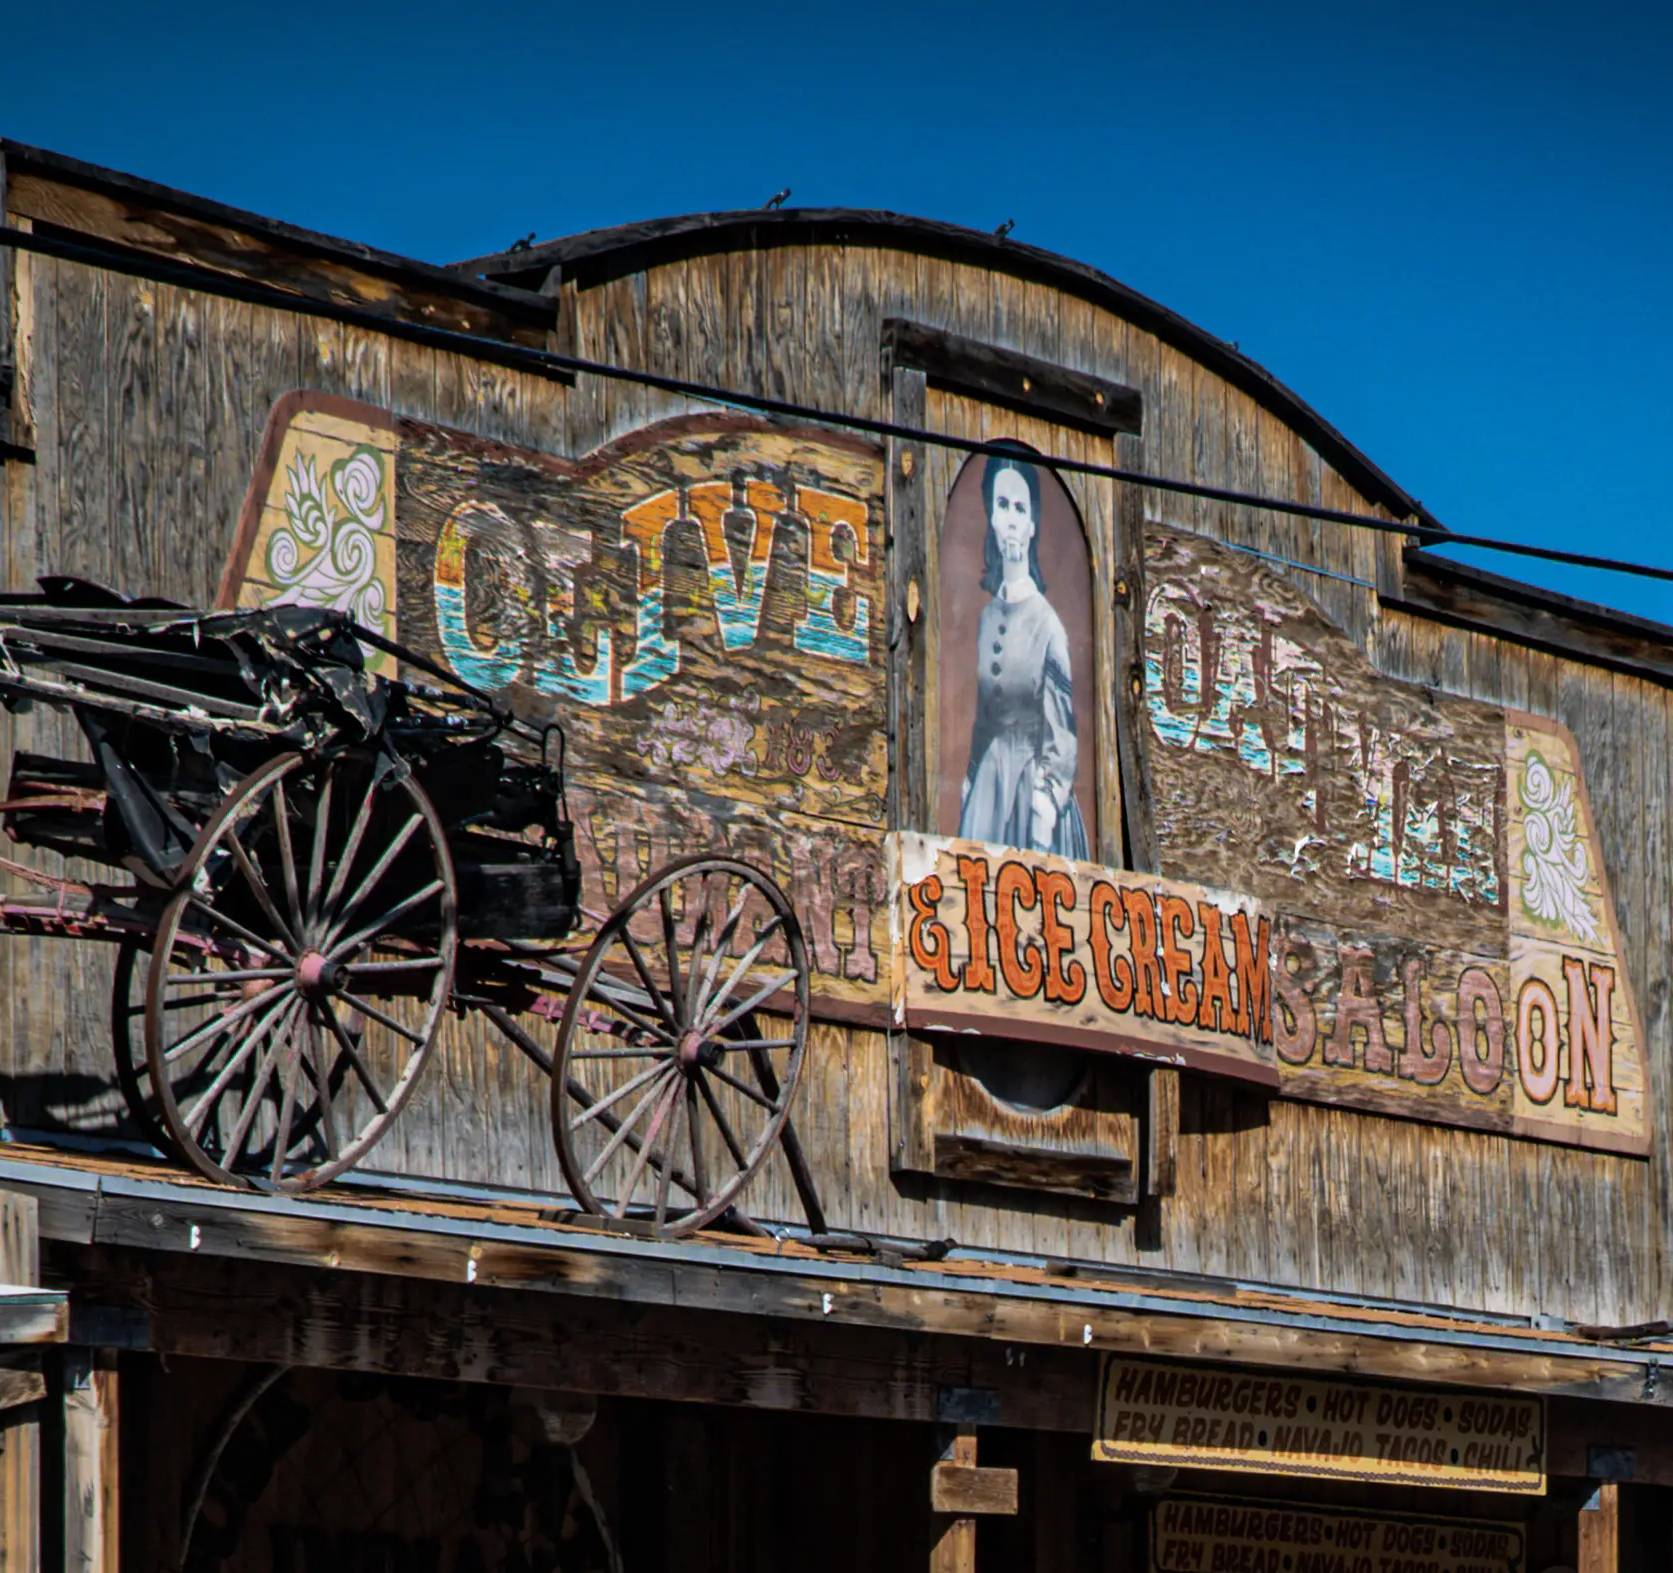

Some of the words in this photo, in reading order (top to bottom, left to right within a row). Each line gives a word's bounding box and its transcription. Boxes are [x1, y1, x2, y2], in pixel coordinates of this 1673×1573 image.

[909, 874, 962, 993] &
[957, 854, 1087, 1006] ICE
[1088, 880, 1275, 1047] CREAM
[1274, 920, 1619, 1117] SALOON
[1116, 1367, 1302, 1419] HAMBURGERS
[1323, 1387, 1370, 1424] HOT
[1376, 1393, 1440, 1431] DOGS
[1459, 1402, 1534, 1439] SODAS
[1114, 1411, 1165, 1444] FRY
[1173, 1416, 1255, 1449] BREAD
[1271, 1426, 1364, 1464] NAVAJO
[1376, 1434, 1446, 1470] TACOS
[1464, 1443, 1523, 1477] CHILI
[1162, 1540, 1203, 1569] FRY
[1163, 1503, 1323, 1546] HAMBURGERS
[1336, 1520, 1376, 1551] HOT
[1382, 1526, 1435, 1554] DOGS
[1451, 1532, 1510, 1560] SODAS
